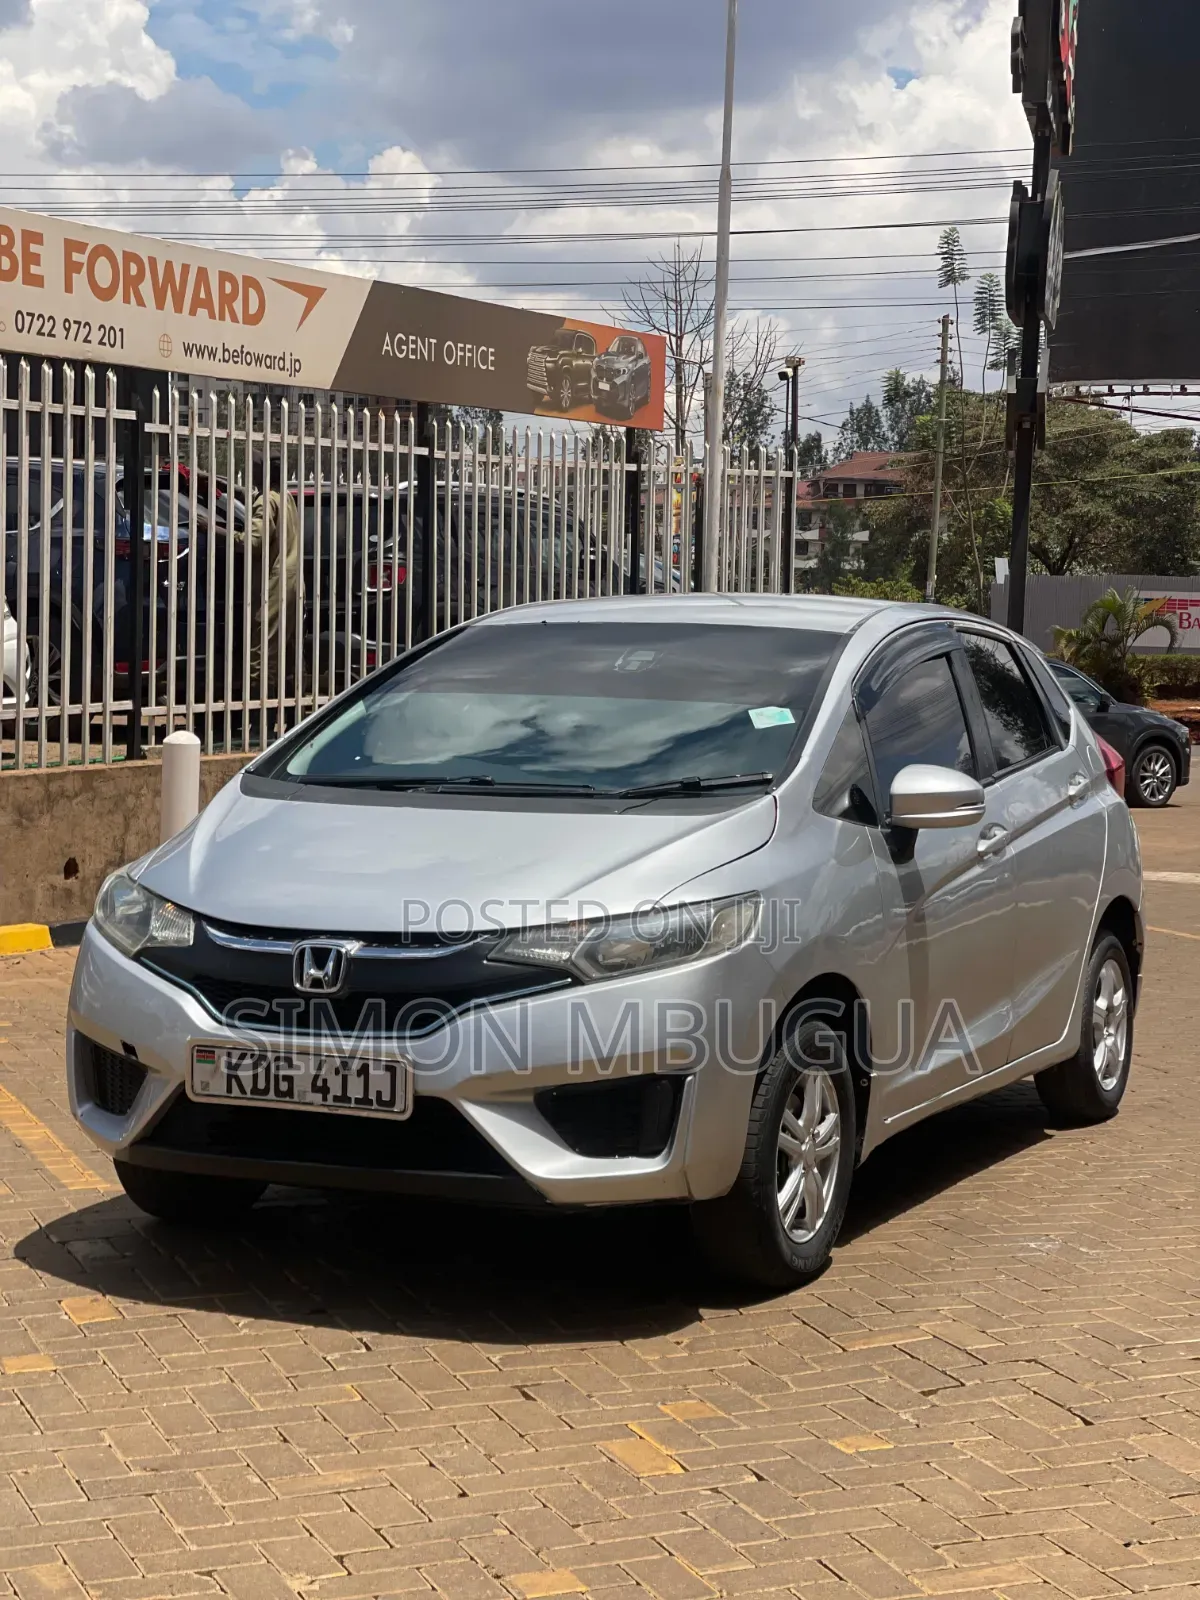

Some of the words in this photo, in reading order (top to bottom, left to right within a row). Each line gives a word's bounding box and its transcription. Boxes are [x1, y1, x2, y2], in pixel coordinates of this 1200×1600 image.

[0, 224, 45, 289] BE
[63, 237, 266, 327] FORWARD
[14, 309, 56, 338] 0722
[62, 317, 92, 344] 972
[97, 323, 124, 349] 201
[182, 339, 302, 378] www.befoward.jp
[381, 331, 437, 361] AGENT
[443, 340, 495, 371] OFFICE
[225, 1051, 294, 1099] KDG
[310, 1058, 397, 1108] 411J
